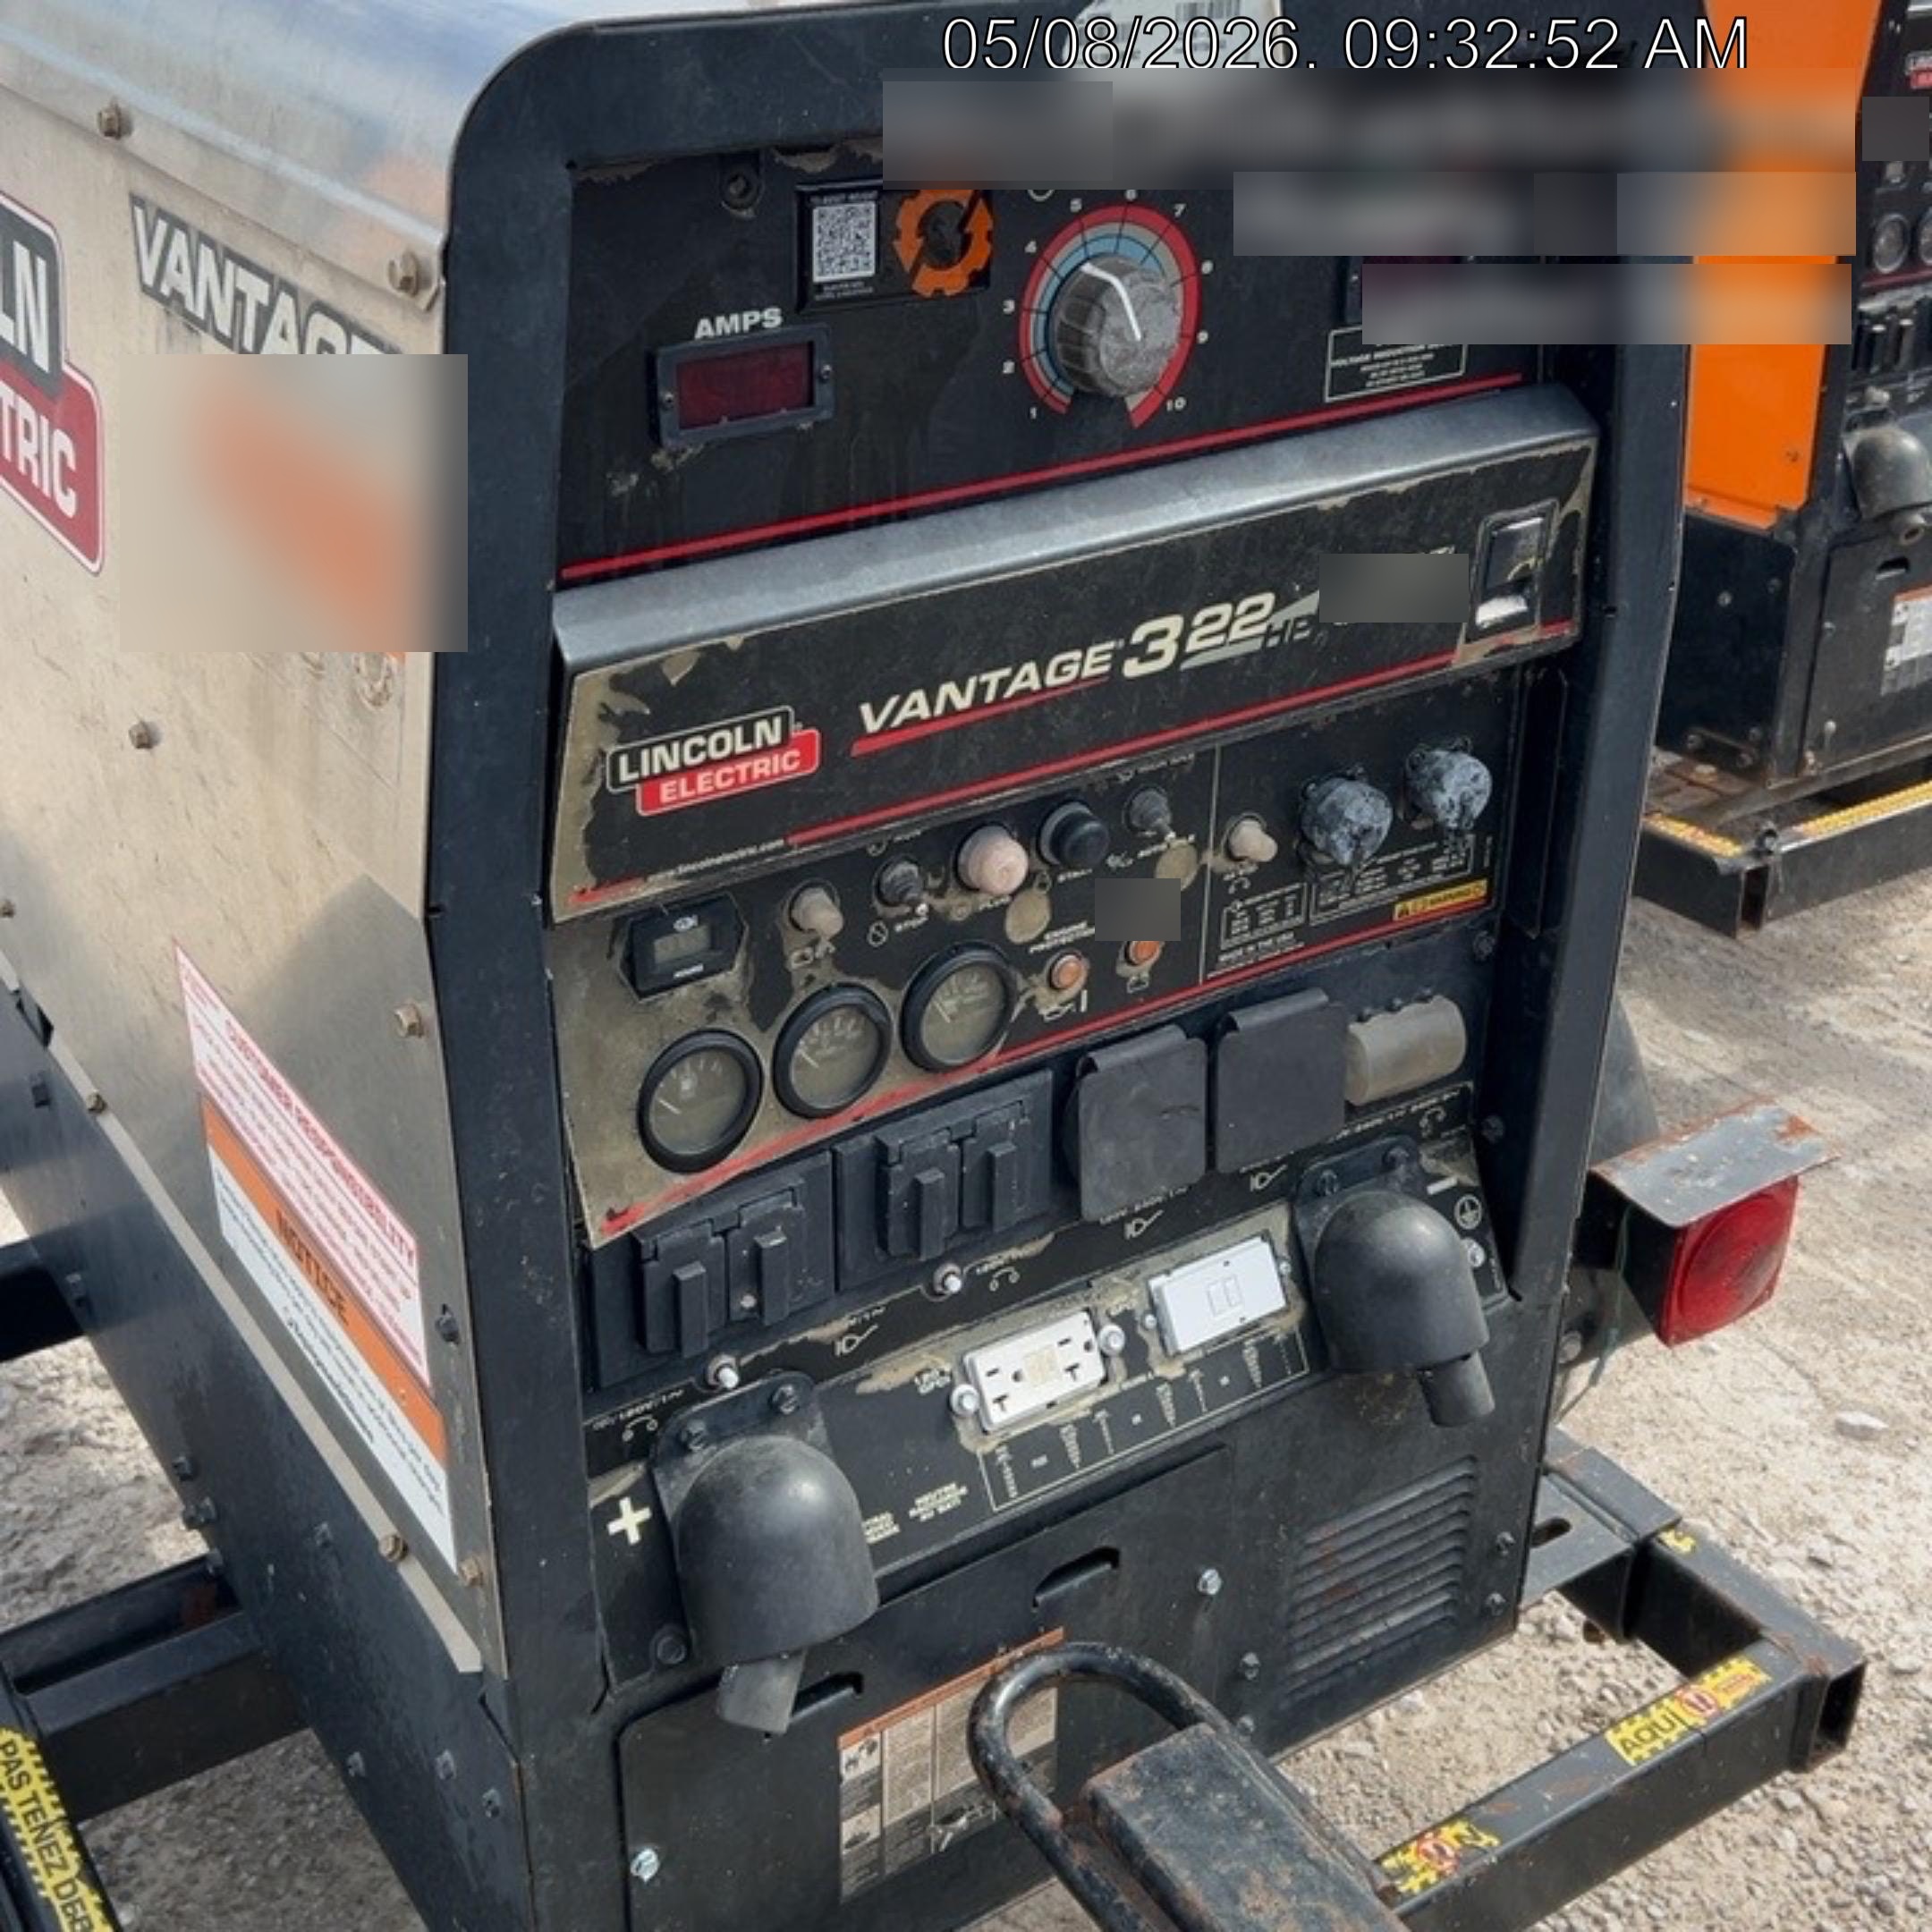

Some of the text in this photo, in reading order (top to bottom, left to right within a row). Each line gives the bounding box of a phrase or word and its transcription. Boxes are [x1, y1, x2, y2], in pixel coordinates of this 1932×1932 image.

[1174, 203, 1187, 217] 7
[134, 204, 386, 355] VANTA
[694, 307, 783, 341] AMPS
[1030, 406, 1038, 419] 1
[1166, 395, 1187, 411] 10
[857, 642, 1116, 735] VANTAGE
[1123, 591, 1276, 680] 322
[617, 715, 783, 784] LINCOLN
[659, 748, 801, 805] ELECTRIC
[1, 1738, 32, 1791] PAS
[16, 1790, 70, 1878] TENEZ
